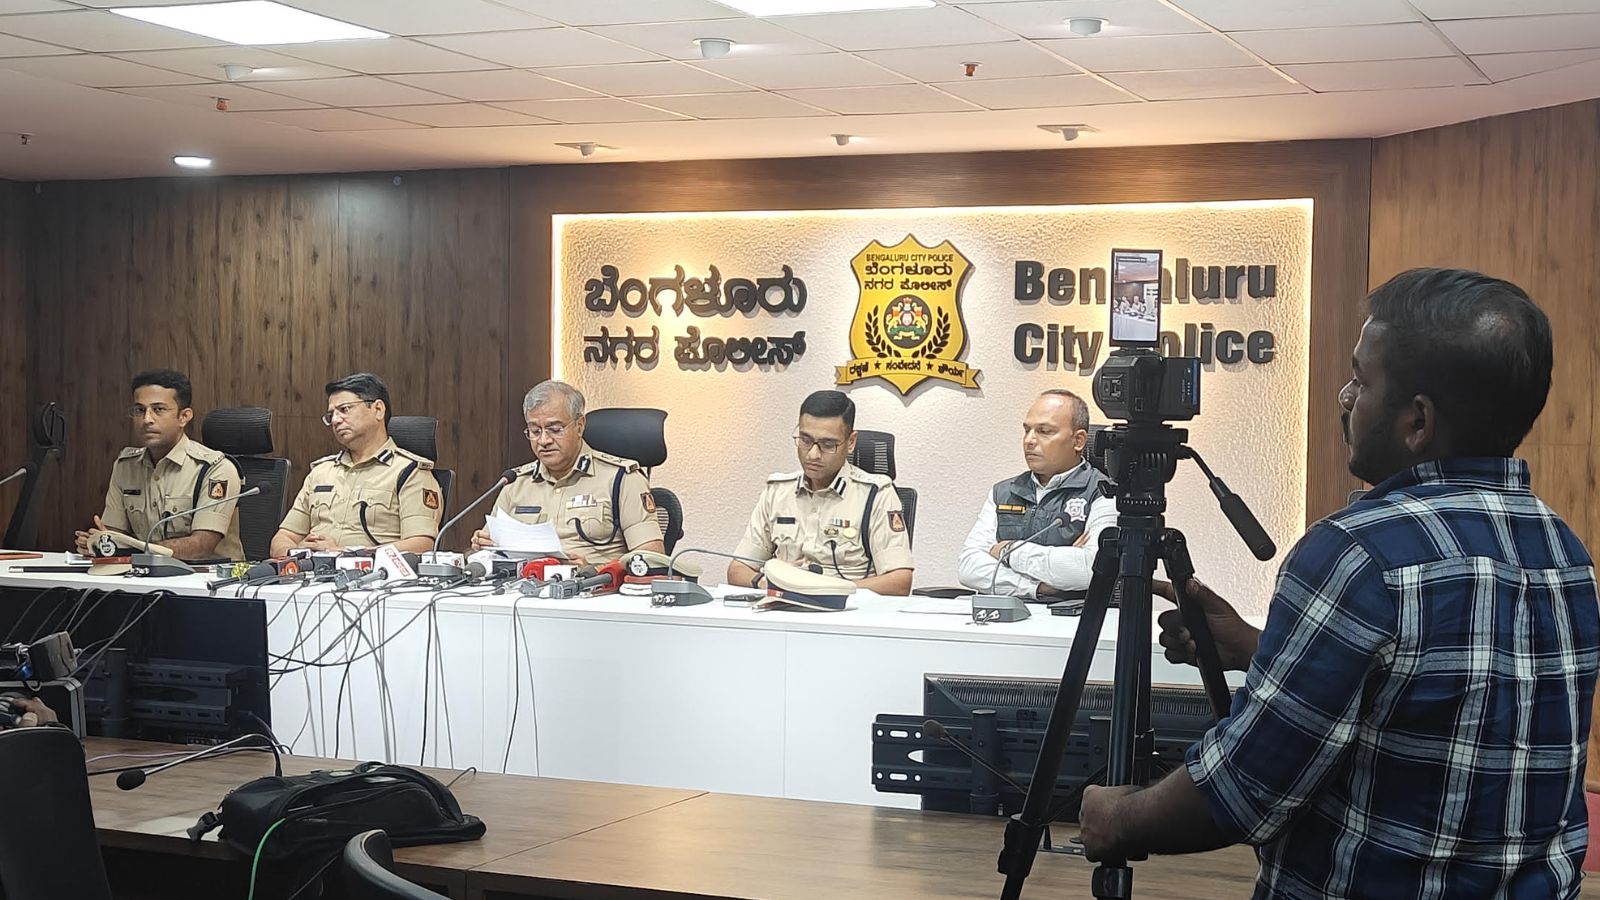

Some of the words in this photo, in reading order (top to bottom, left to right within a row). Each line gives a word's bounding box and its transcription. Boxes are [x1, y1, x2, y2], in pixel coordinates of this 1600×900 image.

[865, 262, 953, 276] ಬೆಂಗಳೂರು
[866, 254, 909, 262] BENGALURU
[911, 254, 926, 262] CITY
[928, 254, 954, 262] POLICE
[584, 264, 807, 317] ಬೆಂಗಳೂರು
[864, 278, 894, 290] ನಗರ
[900, 278, 953, 291] ಪೊಲೀಸ್
[583, 325, 660, 365] ನಗರ
[674, 325, 807, 365] ಪೊಲೀಸ್
[1014, 323, 1104, 369] City
[1158, 323, 1275, 364] olice
